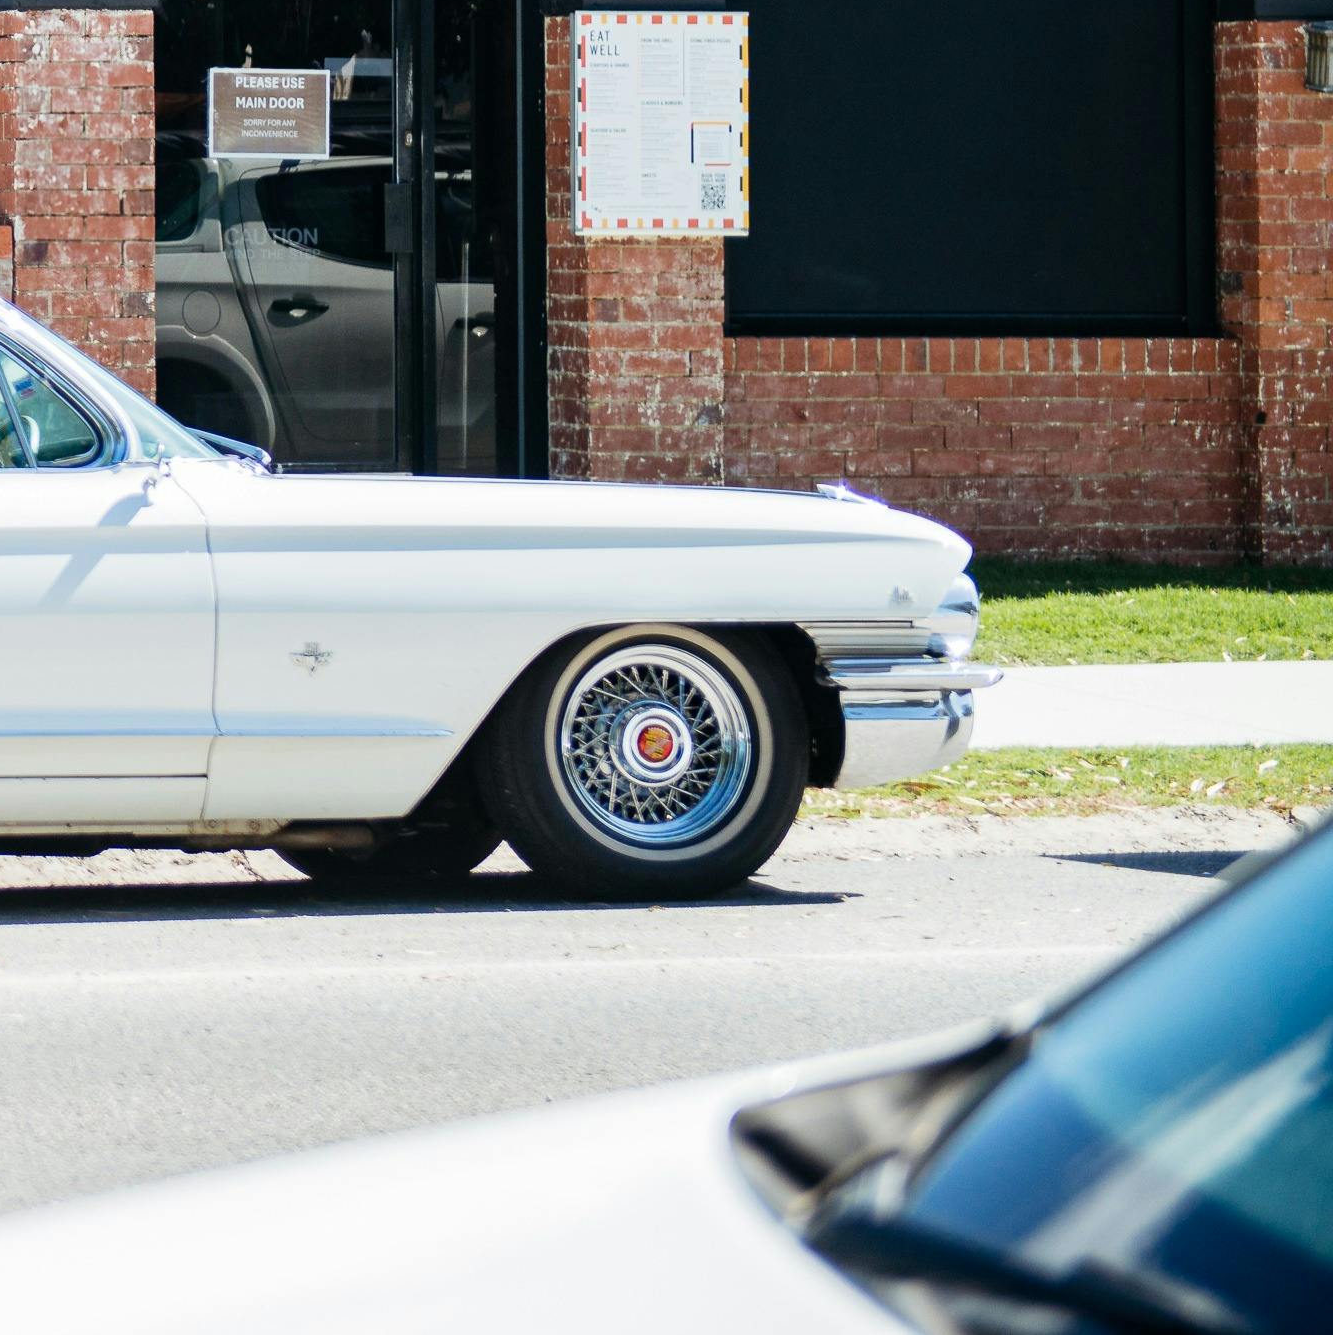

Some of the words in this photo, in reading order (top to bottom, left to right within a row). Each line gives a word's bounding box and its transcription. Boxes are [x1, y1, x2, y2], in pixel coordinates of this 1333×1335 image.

[590, 31, 609, 41] EAT
[589, 45, 620, 55] WELL
[235, 77, 279, 89] PLEASE
[282, 77, 305, 89] USE
[235, 97, 267, 109] MAIN
[269, 97, 305, 109] DOOR
[243, 119, 266, 127] SORRY
[268, 119, 281, 127] FOR
[282, 119, 296, 127] ANY
[224, 227, 317, 245] CAUTION
[261, 249, 280, 259] THE
